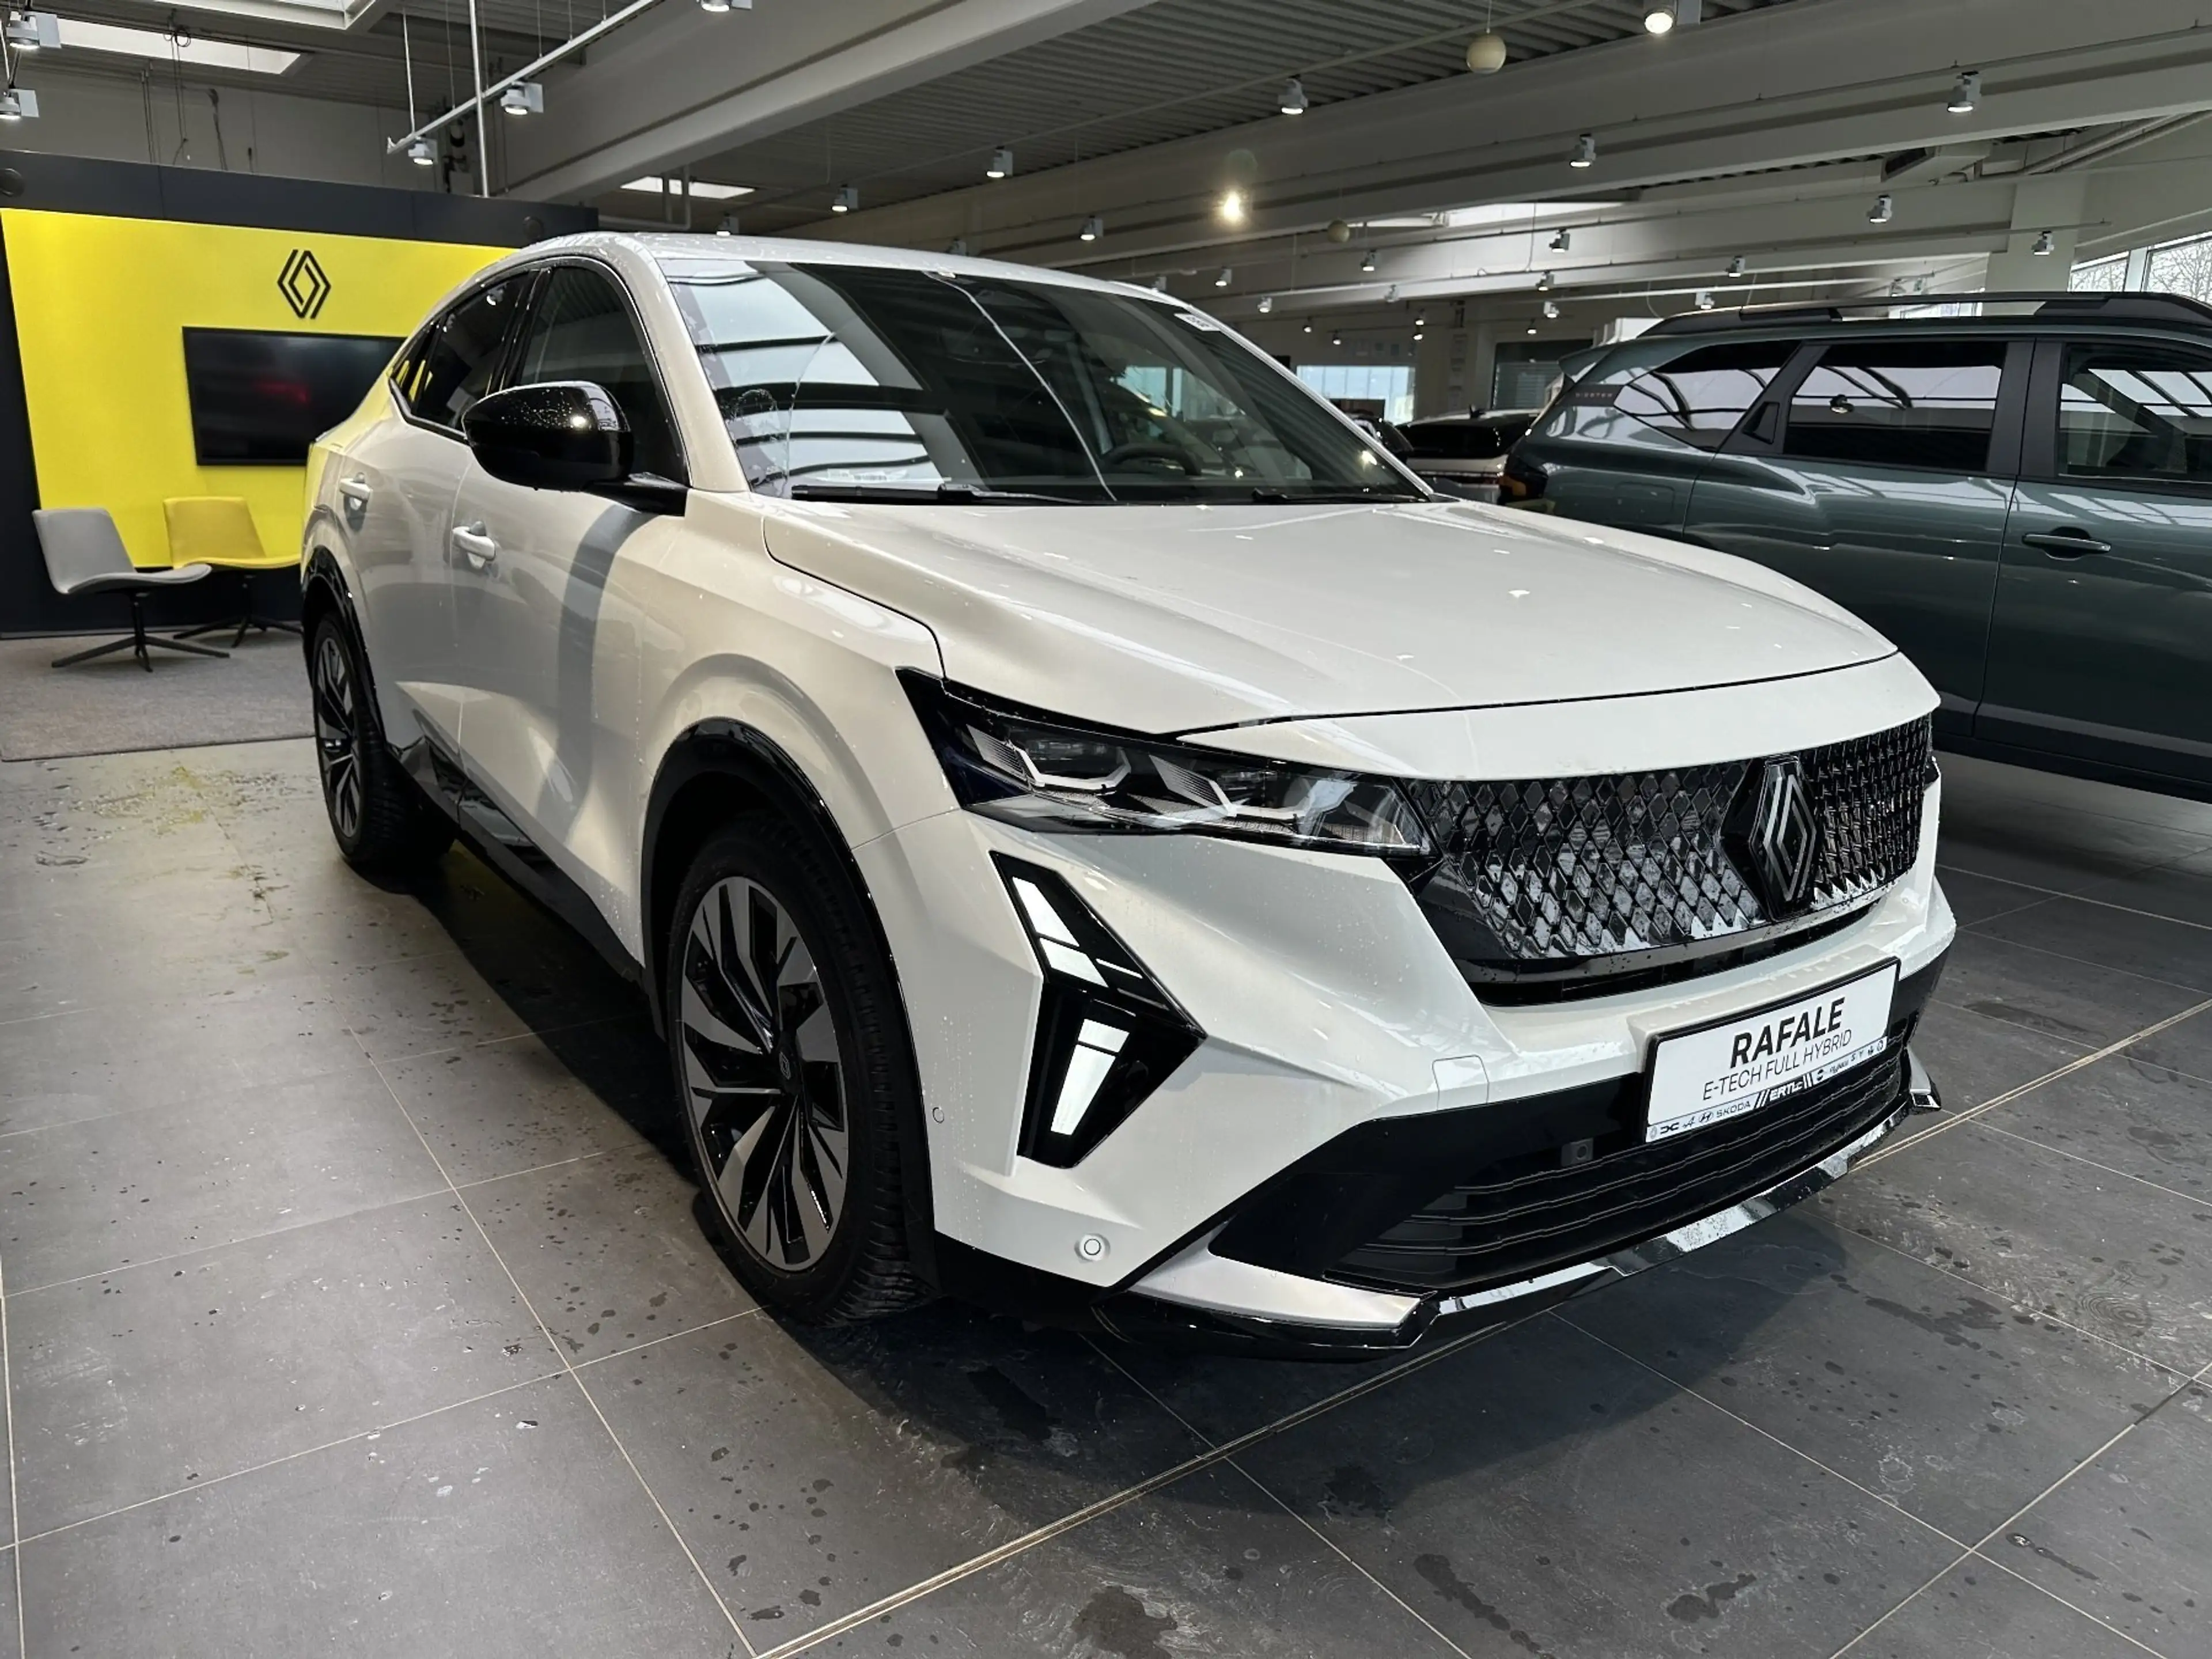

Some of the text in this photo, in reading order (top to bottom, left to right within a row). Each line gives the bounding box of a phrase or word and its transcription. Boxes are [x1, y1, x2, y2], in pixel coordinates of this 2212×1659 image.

[1703, 1029, 1852, 1100] E-TECH FULL HYBRID
[1730, 997, 1845, 1069] RAFALE
